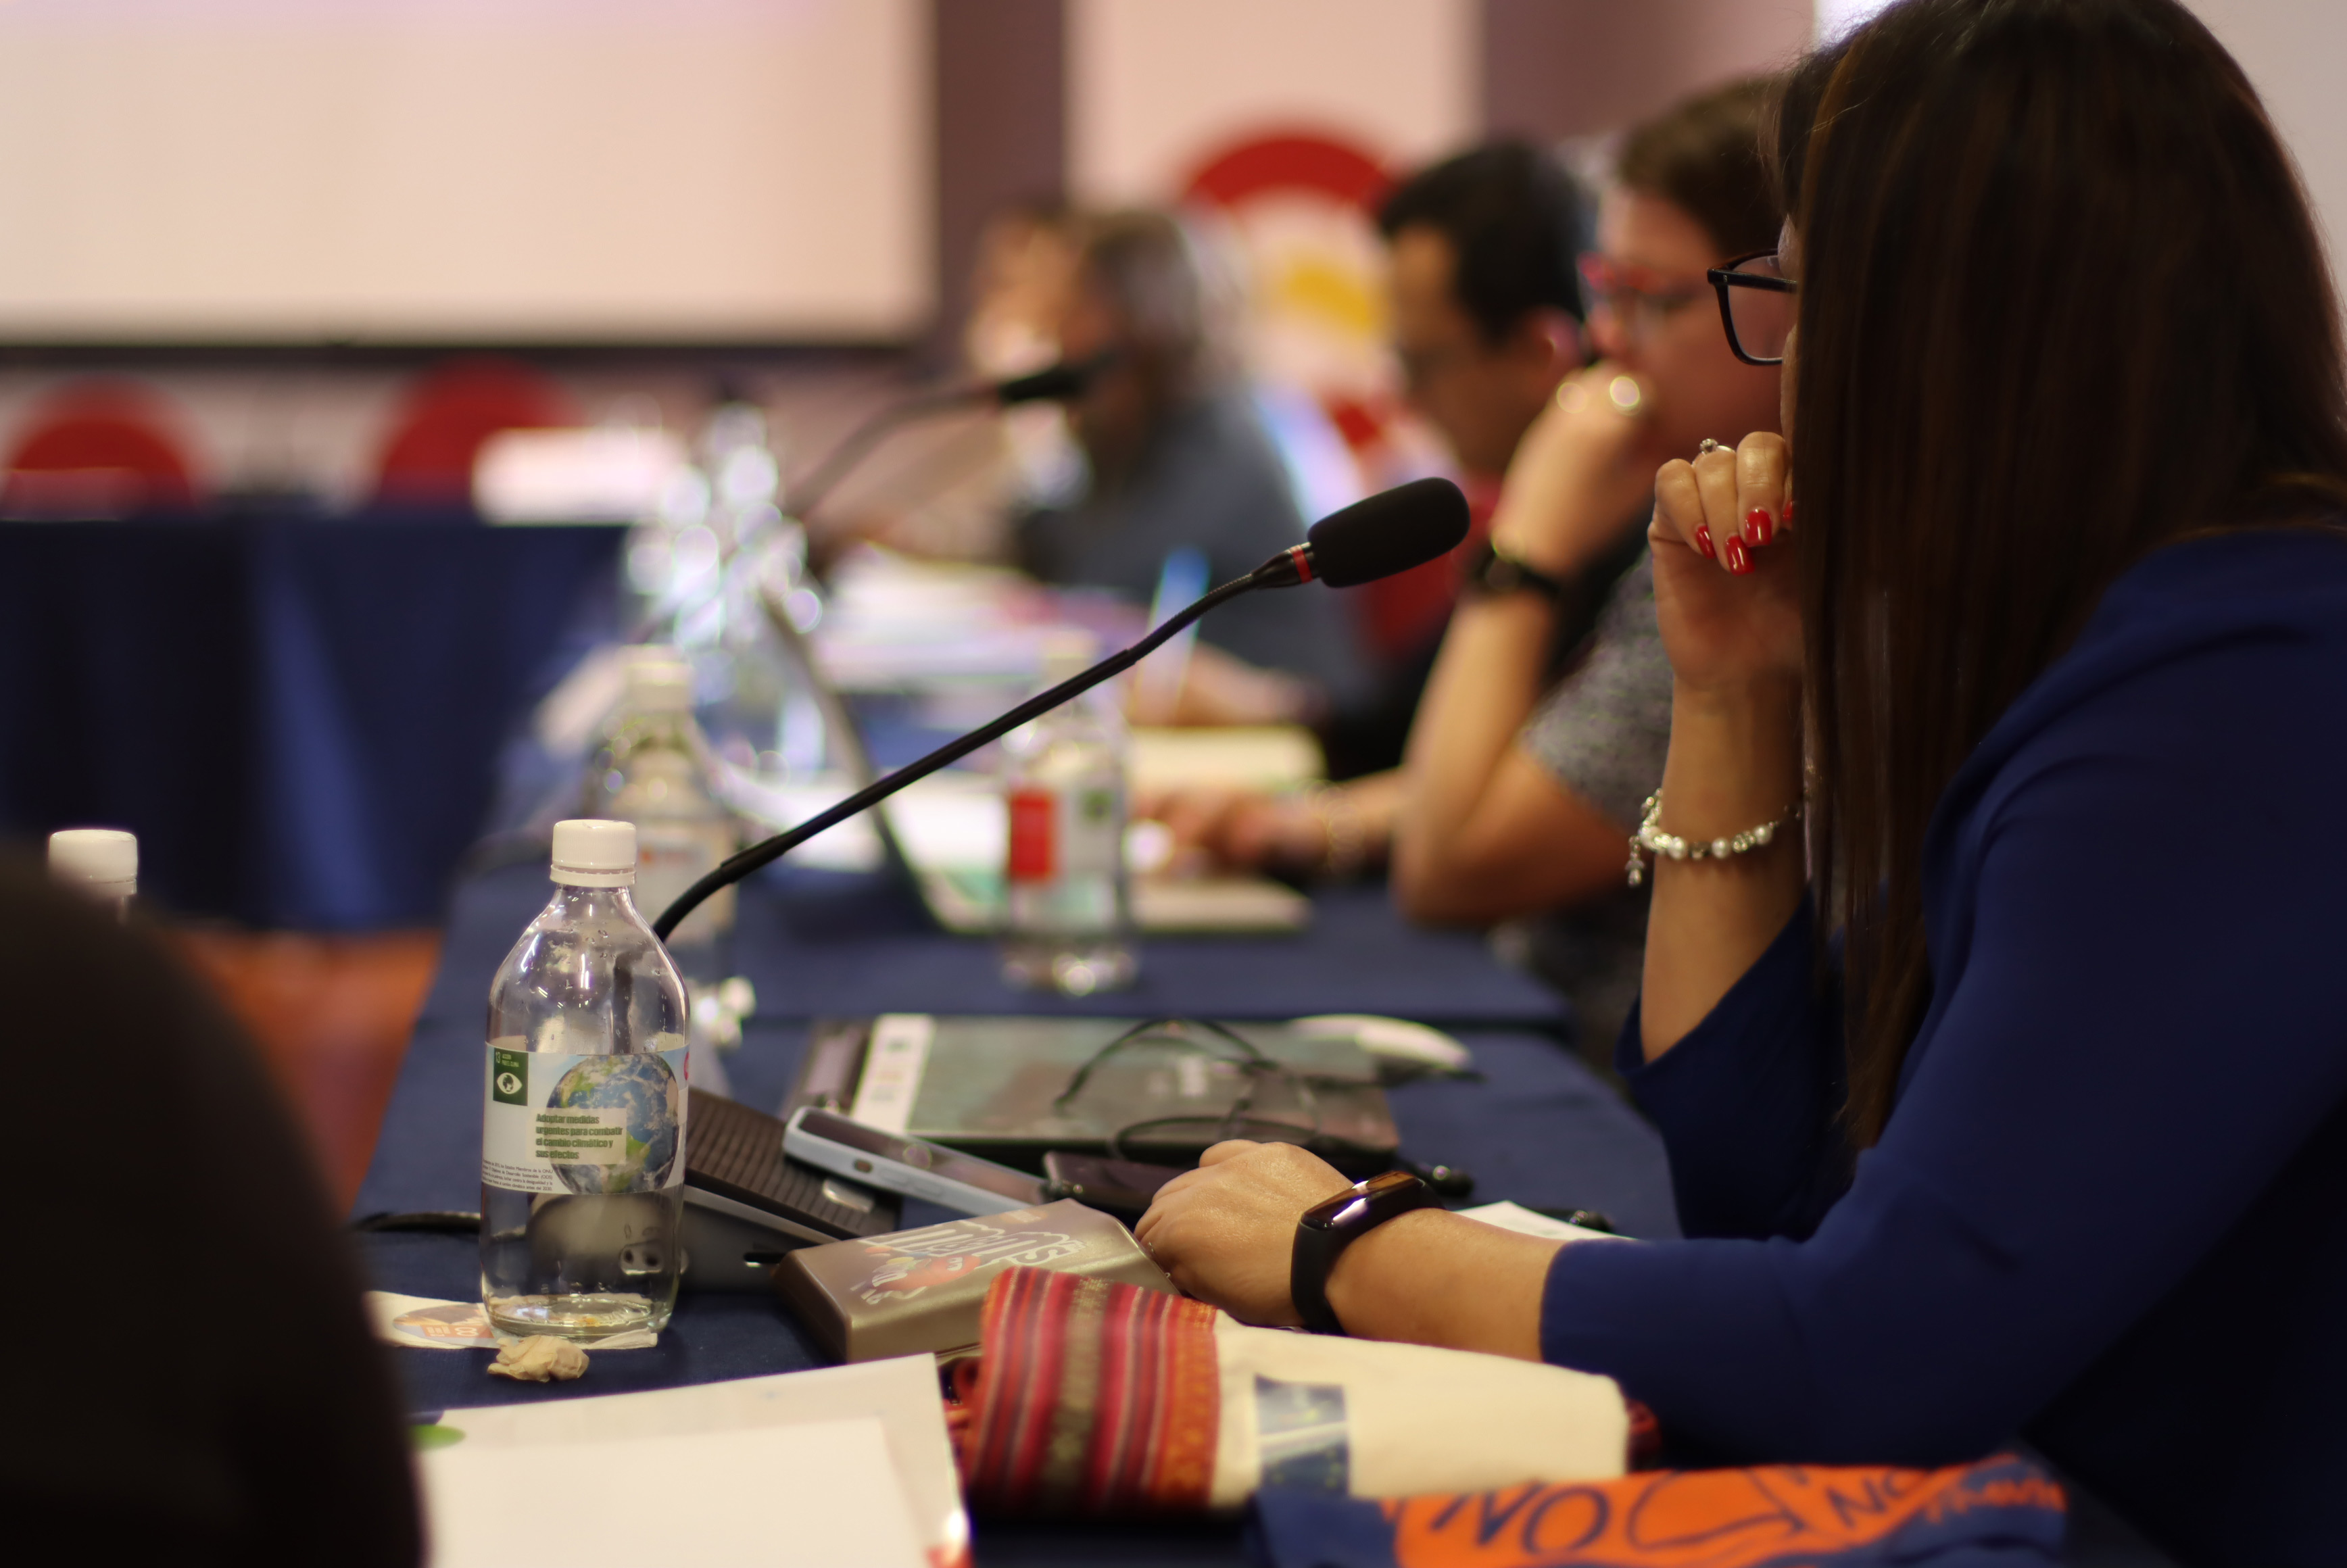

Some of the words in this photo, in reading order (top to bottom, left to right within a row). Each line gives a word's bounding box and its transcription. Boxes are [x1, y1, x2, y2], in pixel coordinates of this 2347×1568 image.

[535, 1114, 565, 1124] Adoptar
[566, 1115, 600, 1124] medidas
[535, 1127, 569, 1135] urgentes
[570, 1127, 588, 1136] para
[589, 1127, 623, 1135] combatir
[535, 1137, 543, 1146] el
[543, 1138, 571, 1147] cambio
[572, 1138, 608, 1147] climático
[608, 1140, 614, 1148] y
[550, 1150, 579, 1159] efectos
